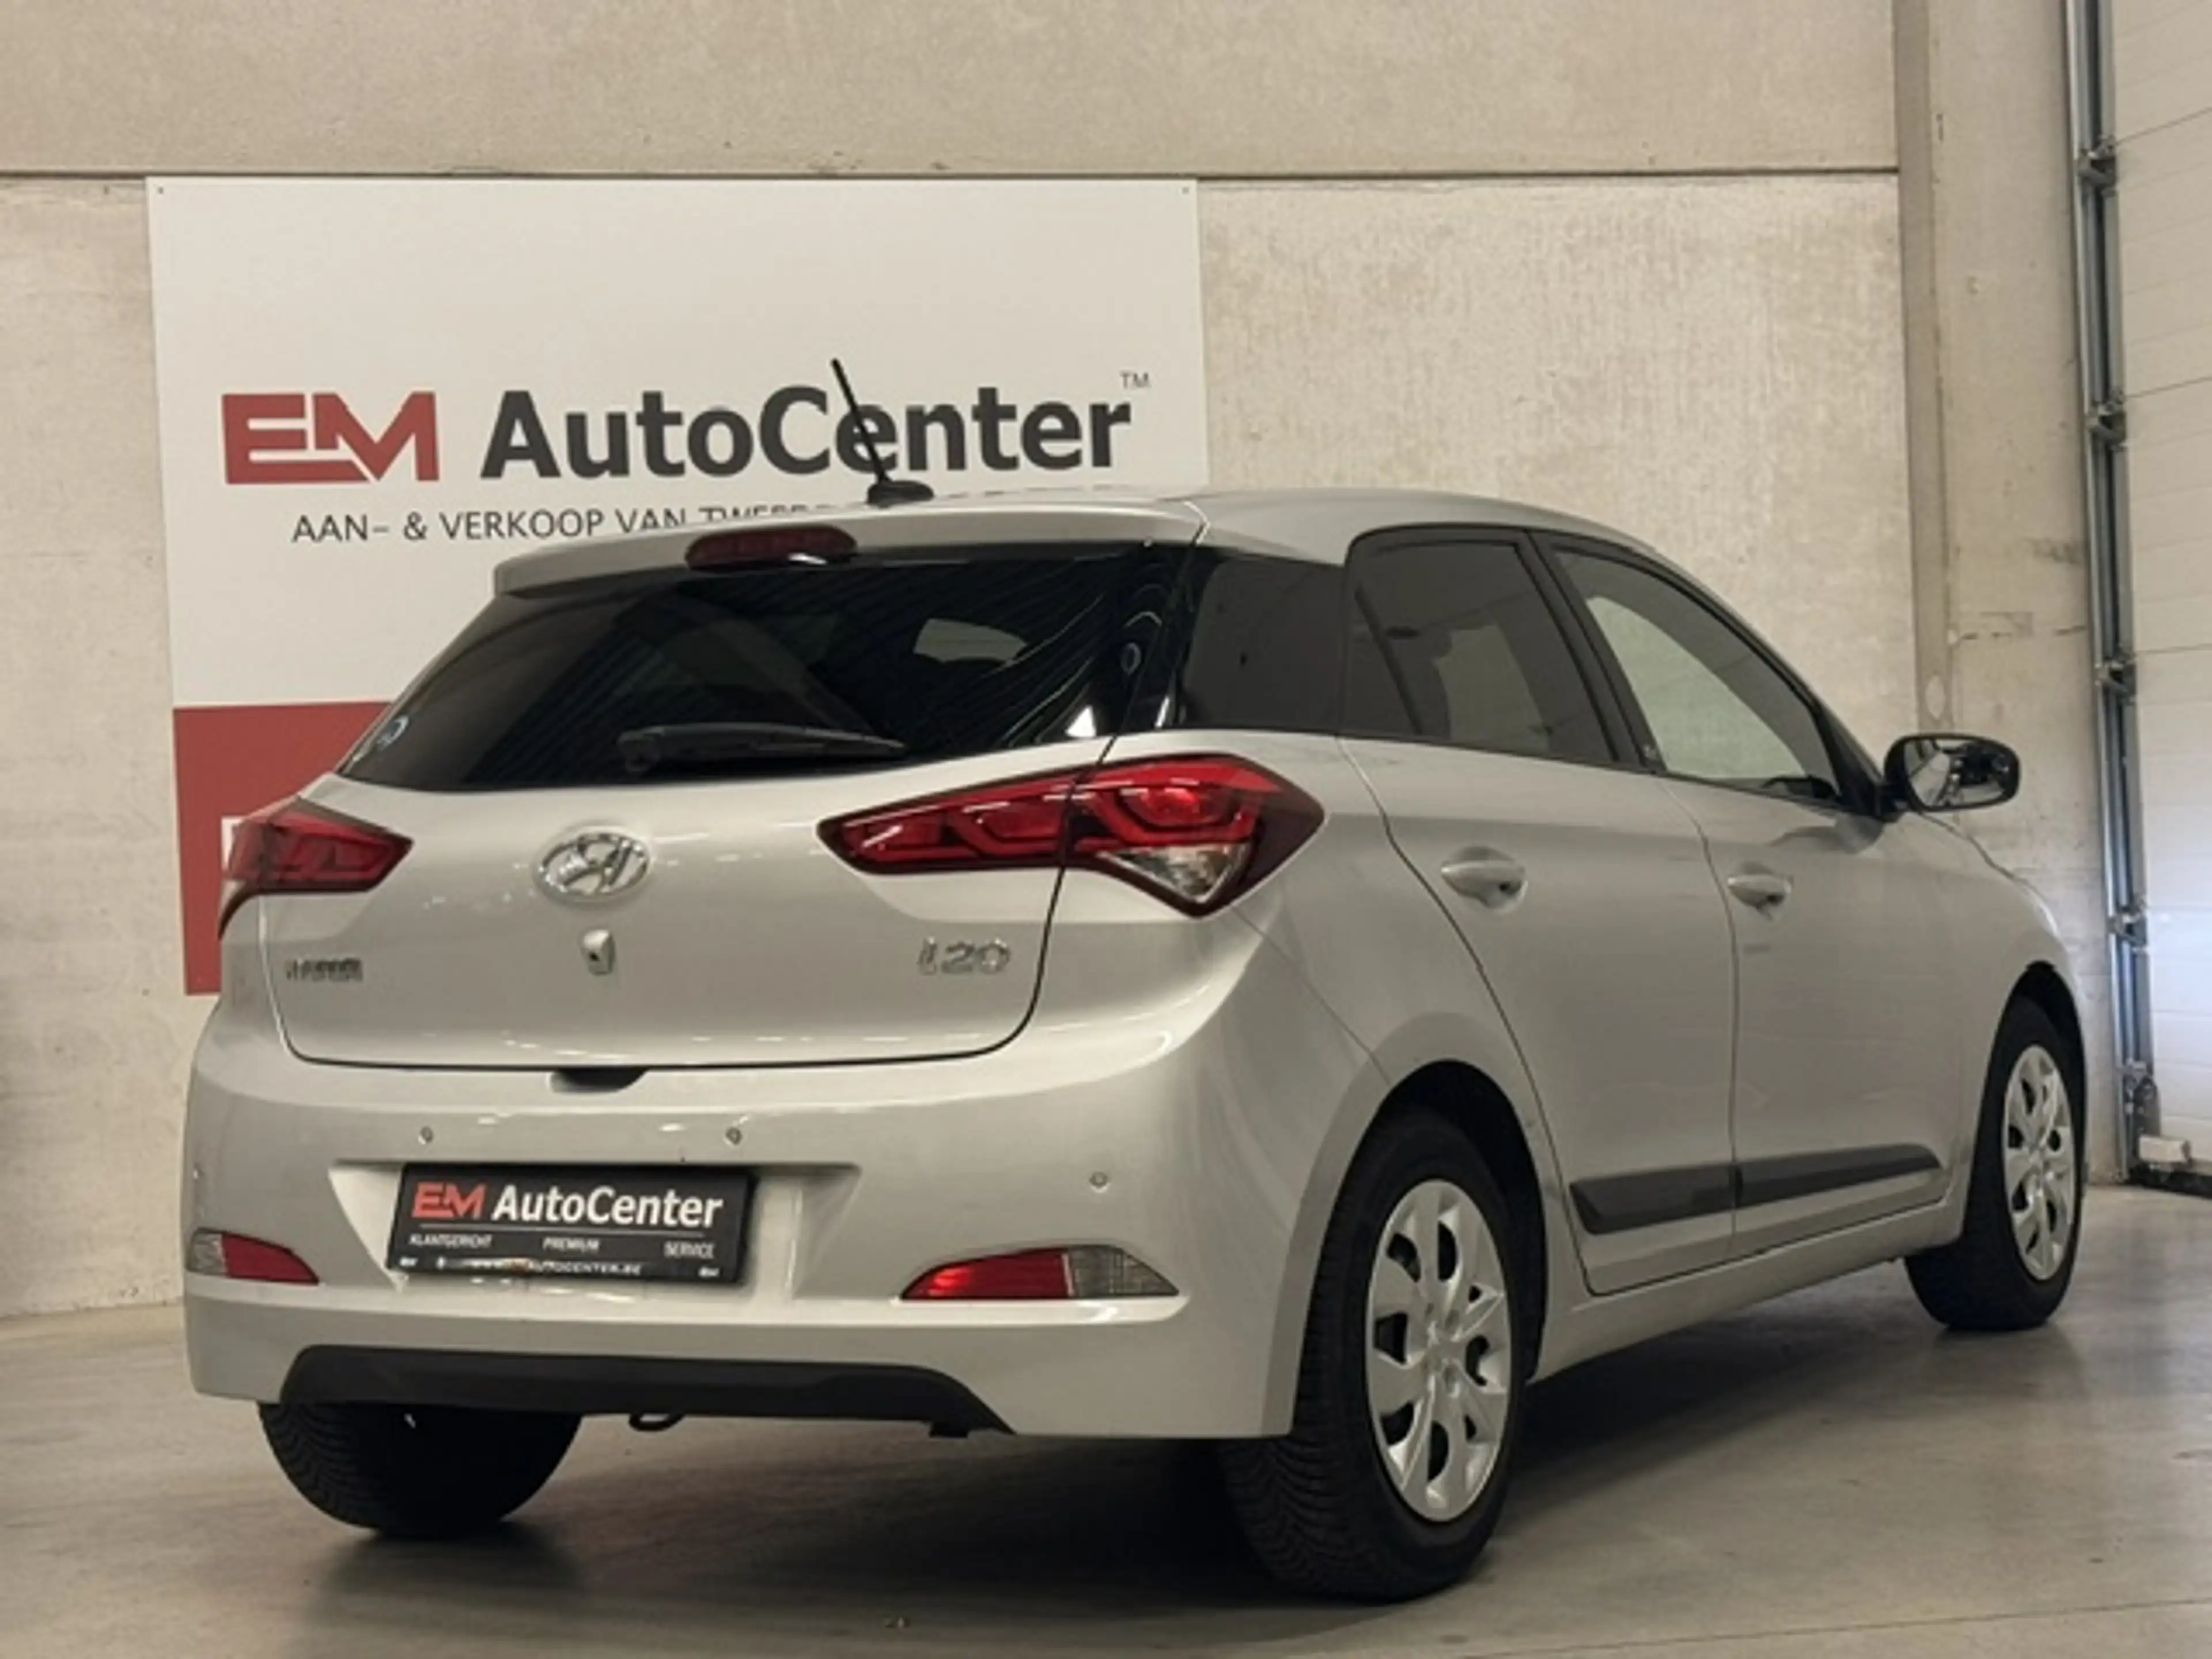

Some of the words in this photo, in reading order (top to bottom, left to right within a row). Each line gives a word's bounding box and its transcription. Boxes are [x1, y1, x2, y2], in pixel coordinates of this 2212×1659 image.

[221, 391, 440, 484] EM
[480, 385, 1131, 479] AutoCenter
[403, 512, 428, 540] &
[440, 508, 604, 540] VERKOOP
[614, 506, 687, 534] VAN
[411, 1183, 486, 1220] EM
[492, 1184, 722, 1227] AutoCenter
[543, 1237, 600, 1254] PREMIUM
[664, 1241, 714, 1259] SERVICE
